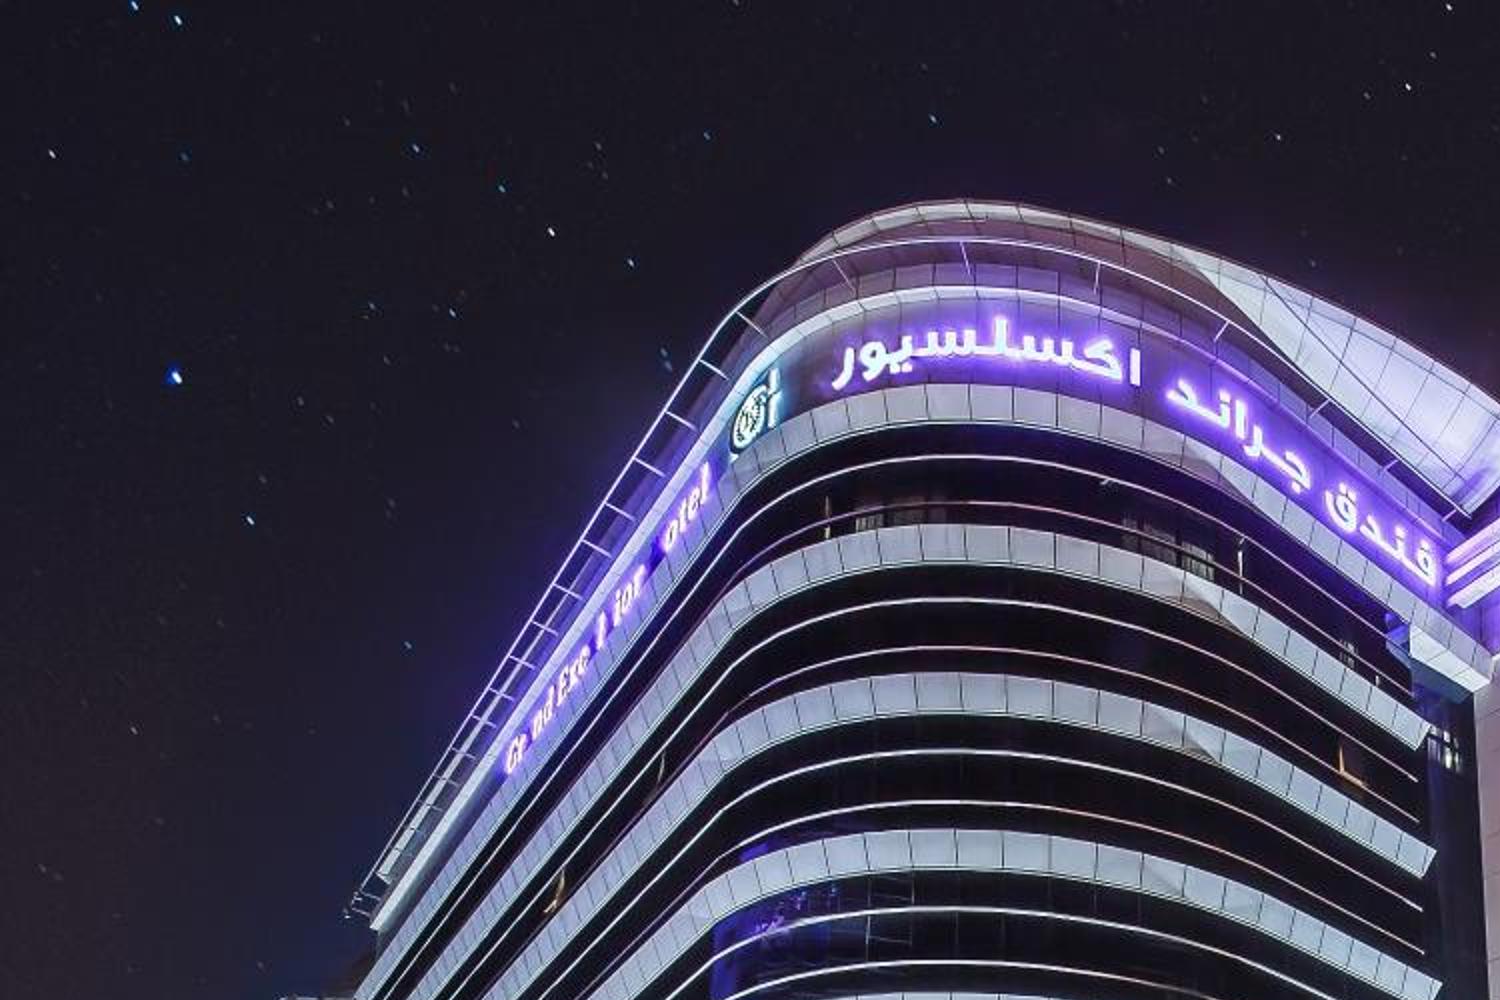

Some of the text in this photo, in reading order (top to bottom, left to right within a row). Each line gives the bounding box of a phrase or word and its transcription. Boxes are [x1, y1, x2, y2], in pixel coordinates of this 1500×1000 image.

[831, 316, 1437, 588] فندق جراند اكسلسيور
[506, 686, 556, 775] Grnd
[660, 461, 712, 555] otel
